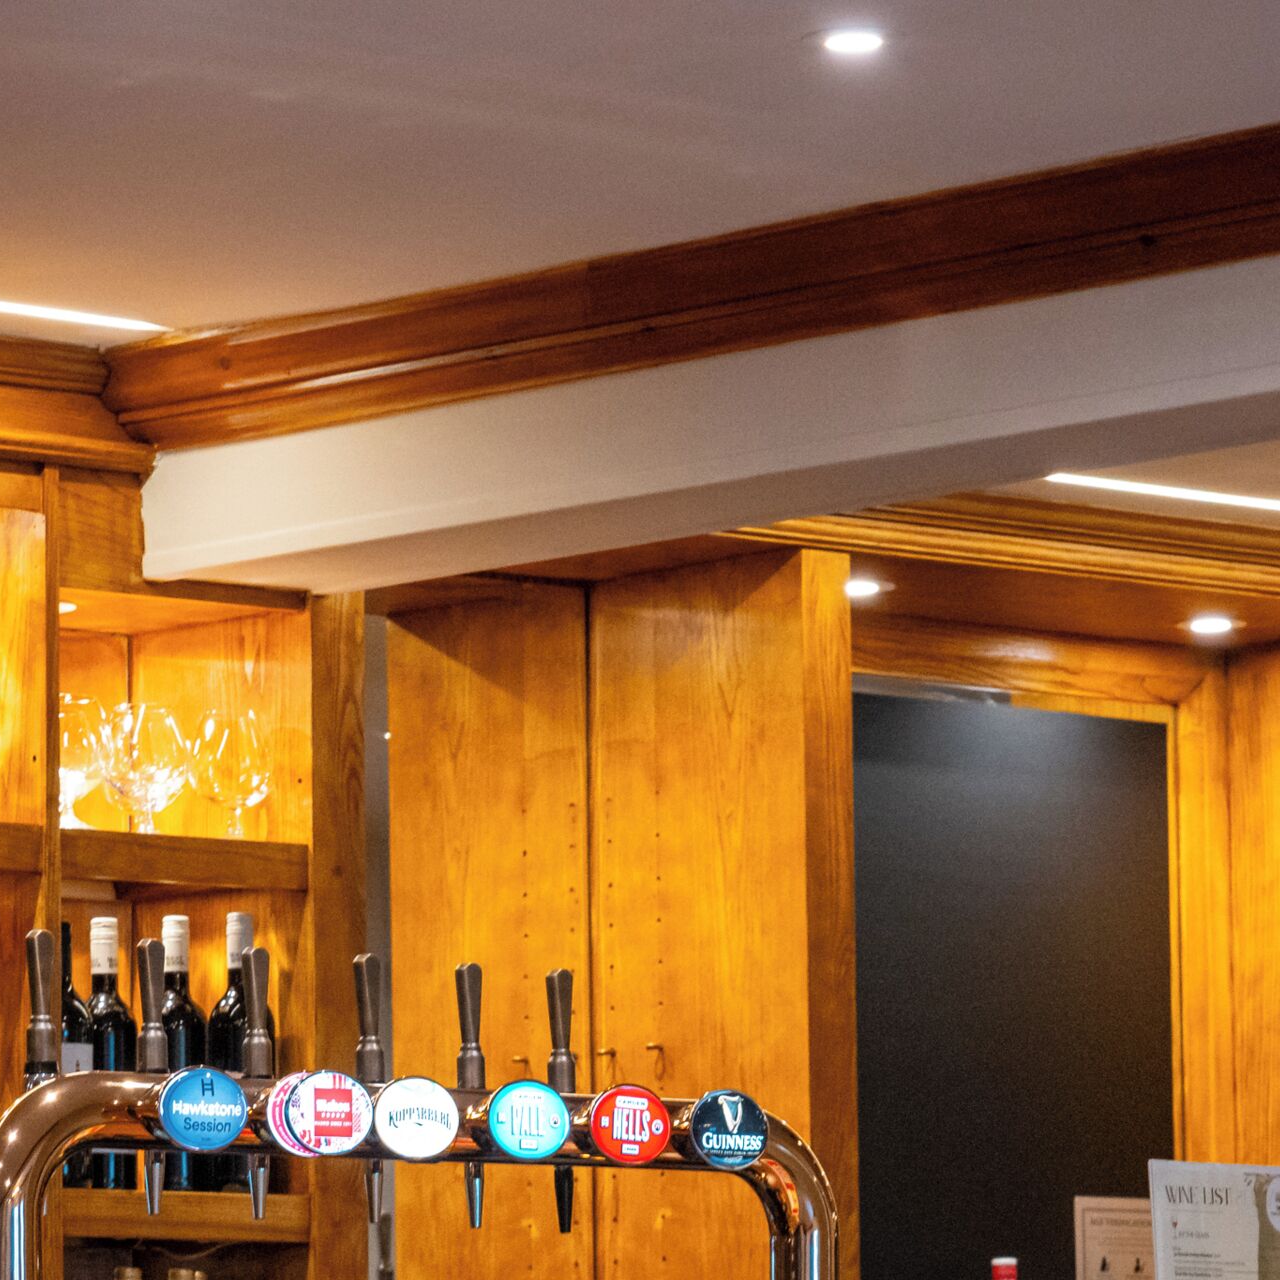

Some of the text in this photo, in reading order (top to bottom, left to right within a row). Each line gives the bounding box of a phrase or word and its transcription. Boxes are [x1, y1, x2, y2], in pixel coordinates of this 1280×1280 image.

[172, 1100, 242, 1117] Hawkstone
[183, 1119, 232, 1134] Session
[612, 1107, 651, 1143] HELLS
[702, 1131, 763, 1151] GUINNESS
[1164, 1184, 1232, 1206] WINE LIST
